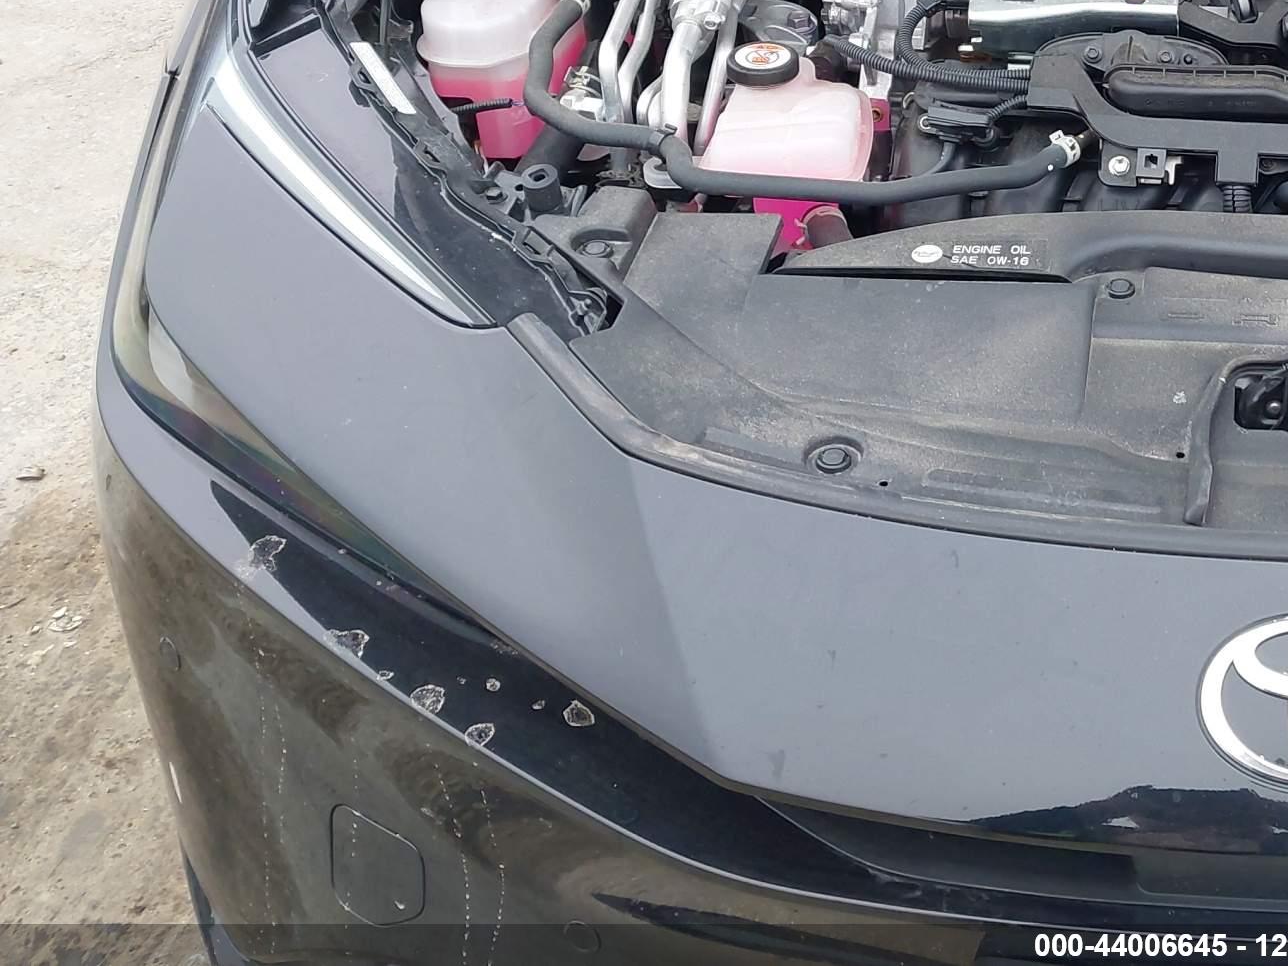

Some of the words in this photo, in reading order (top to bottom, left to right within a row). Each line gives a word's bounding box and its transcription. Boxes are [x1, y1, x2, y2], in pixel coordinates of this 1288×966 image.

[952, 244, 1002, 254] ENGINE
[1010, 244, 1032, 255] OIL
[950, 255, 978, 264] SAE
